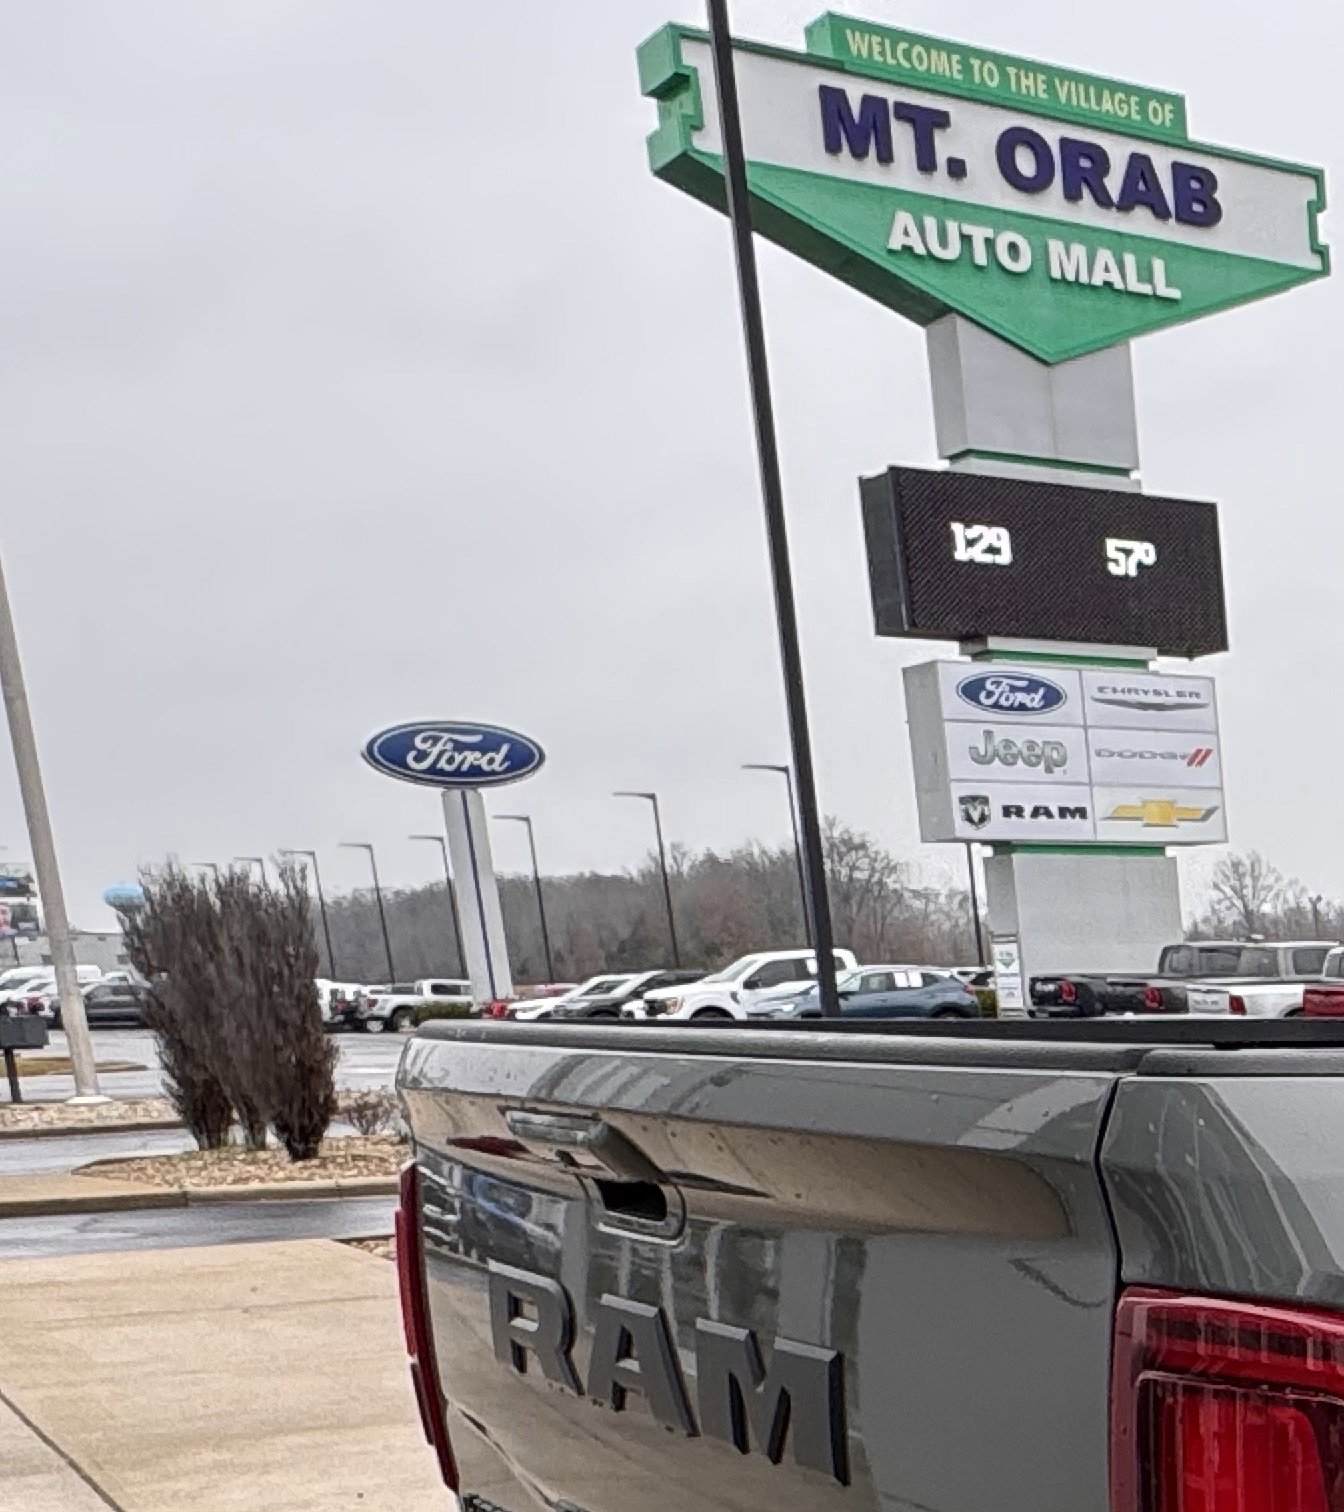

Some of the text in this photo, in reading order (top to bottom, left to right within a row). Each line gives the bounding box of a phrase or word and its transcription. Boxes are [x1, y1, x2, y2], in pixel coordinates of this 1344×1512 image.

[845, 28, 1175, 128] WELCOME TO THE VILLAGE OF
[818, 84, 1224, 227] MT. ORAB
[886, 211, 1183, 301] AUTO MALL
[978, 676, 1047, 709] Ford
[1096, 686, 1201, 700] CHRYSLER
[406, 731, 512, 773] Ford
[968, 729, 1068, 774] Jeep
[1001, 804, 1088, 820] RAM
[486, 1258, 851, 1487] RAM
